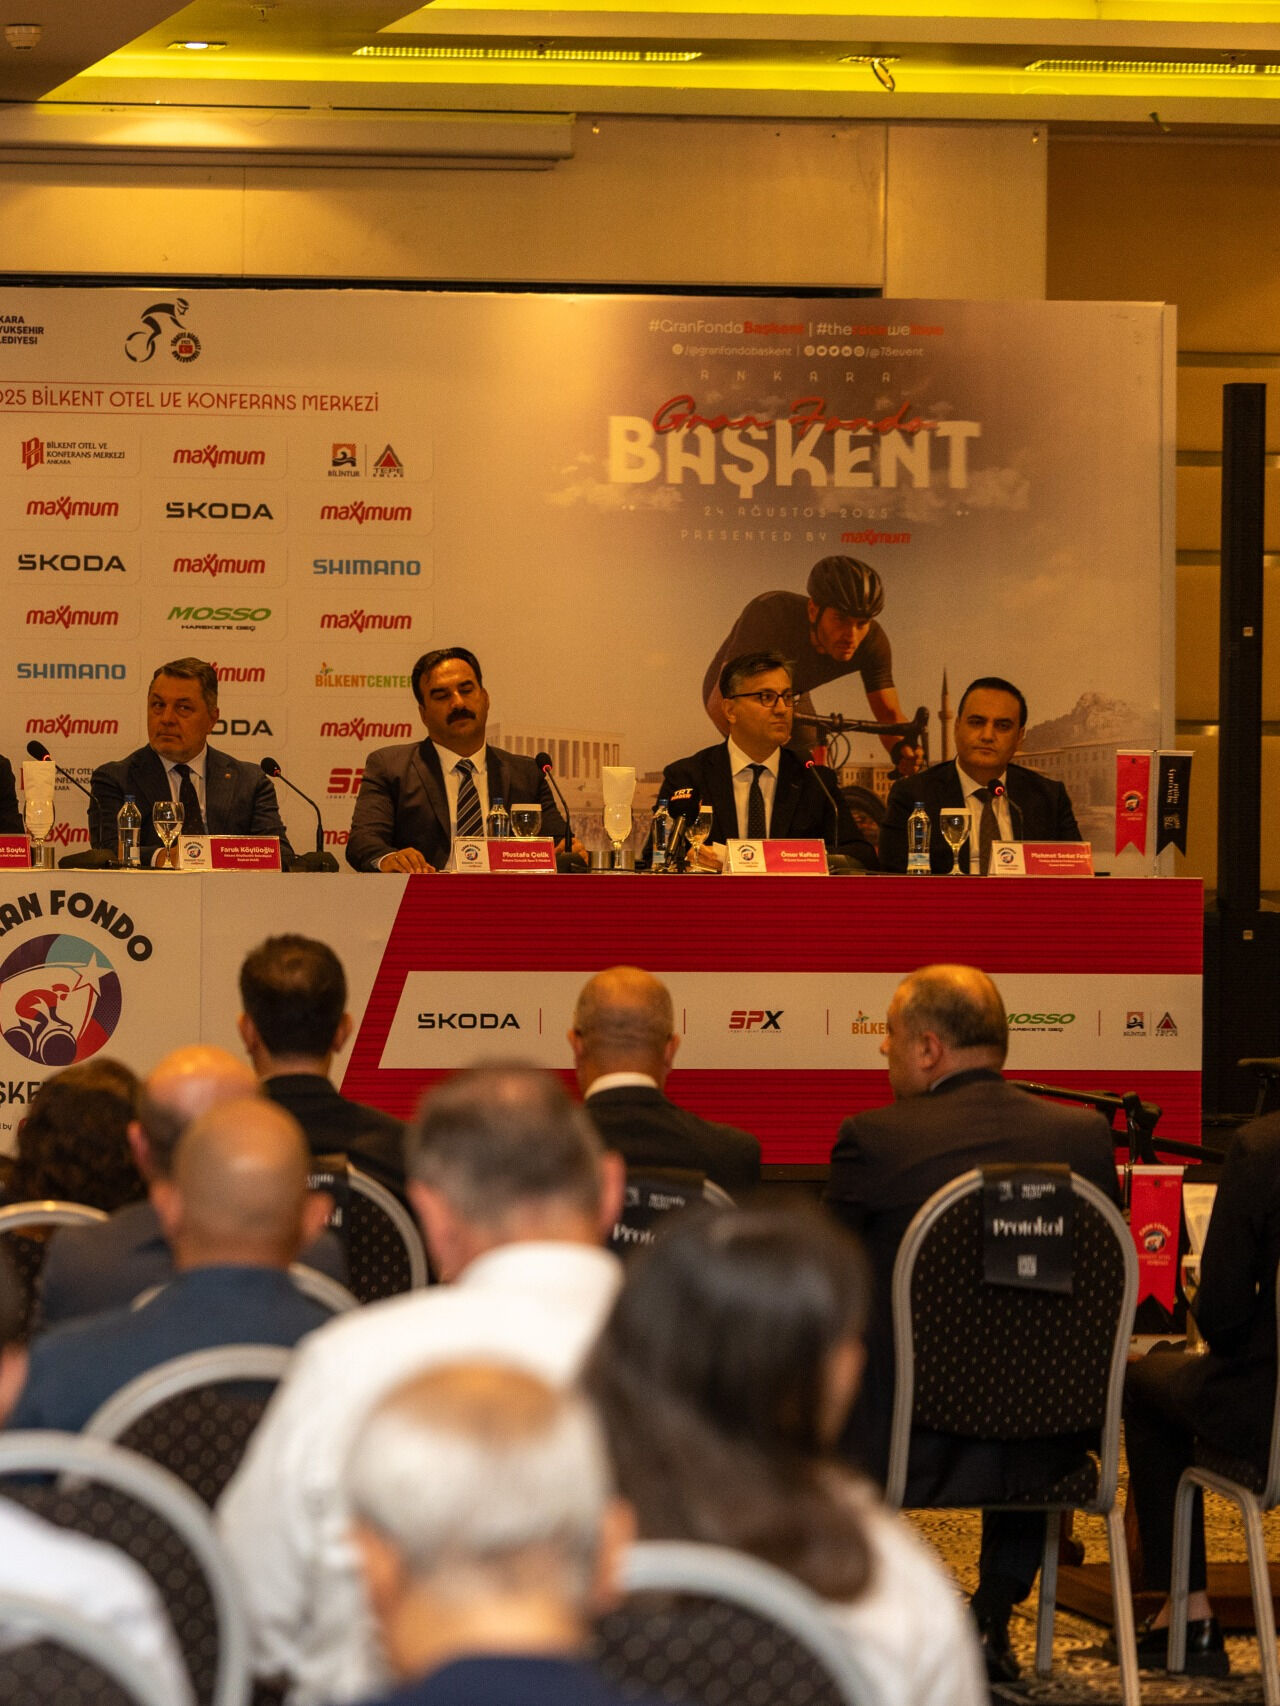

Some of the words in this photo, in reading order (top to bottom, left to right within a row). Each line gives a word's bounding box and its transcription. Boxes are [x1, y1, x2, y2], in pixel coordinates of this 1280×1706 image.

[31, 386, 105, 407] BİLKENT
[109, 390, 155, 409] OTEL
[187, 391, 297, 410] KONFERANS
[302, 391, 379, 412] MERKEZİ
[608, 414, 983, 499] BAŞKENT
[680, 529, 792, 543] PRESENTED
[312, 559, 422, 576] SHIMANO
[167, 607, 272, 622] MOSSO
[16, 662, 127, 681] SHIMANO
[49, 889, 154, 962] FONDO
[728, 1010, 785, 1030] SPX
[2, 1122, 13, 1132] by
[992, 1215, 1064, 1237] Protokol
